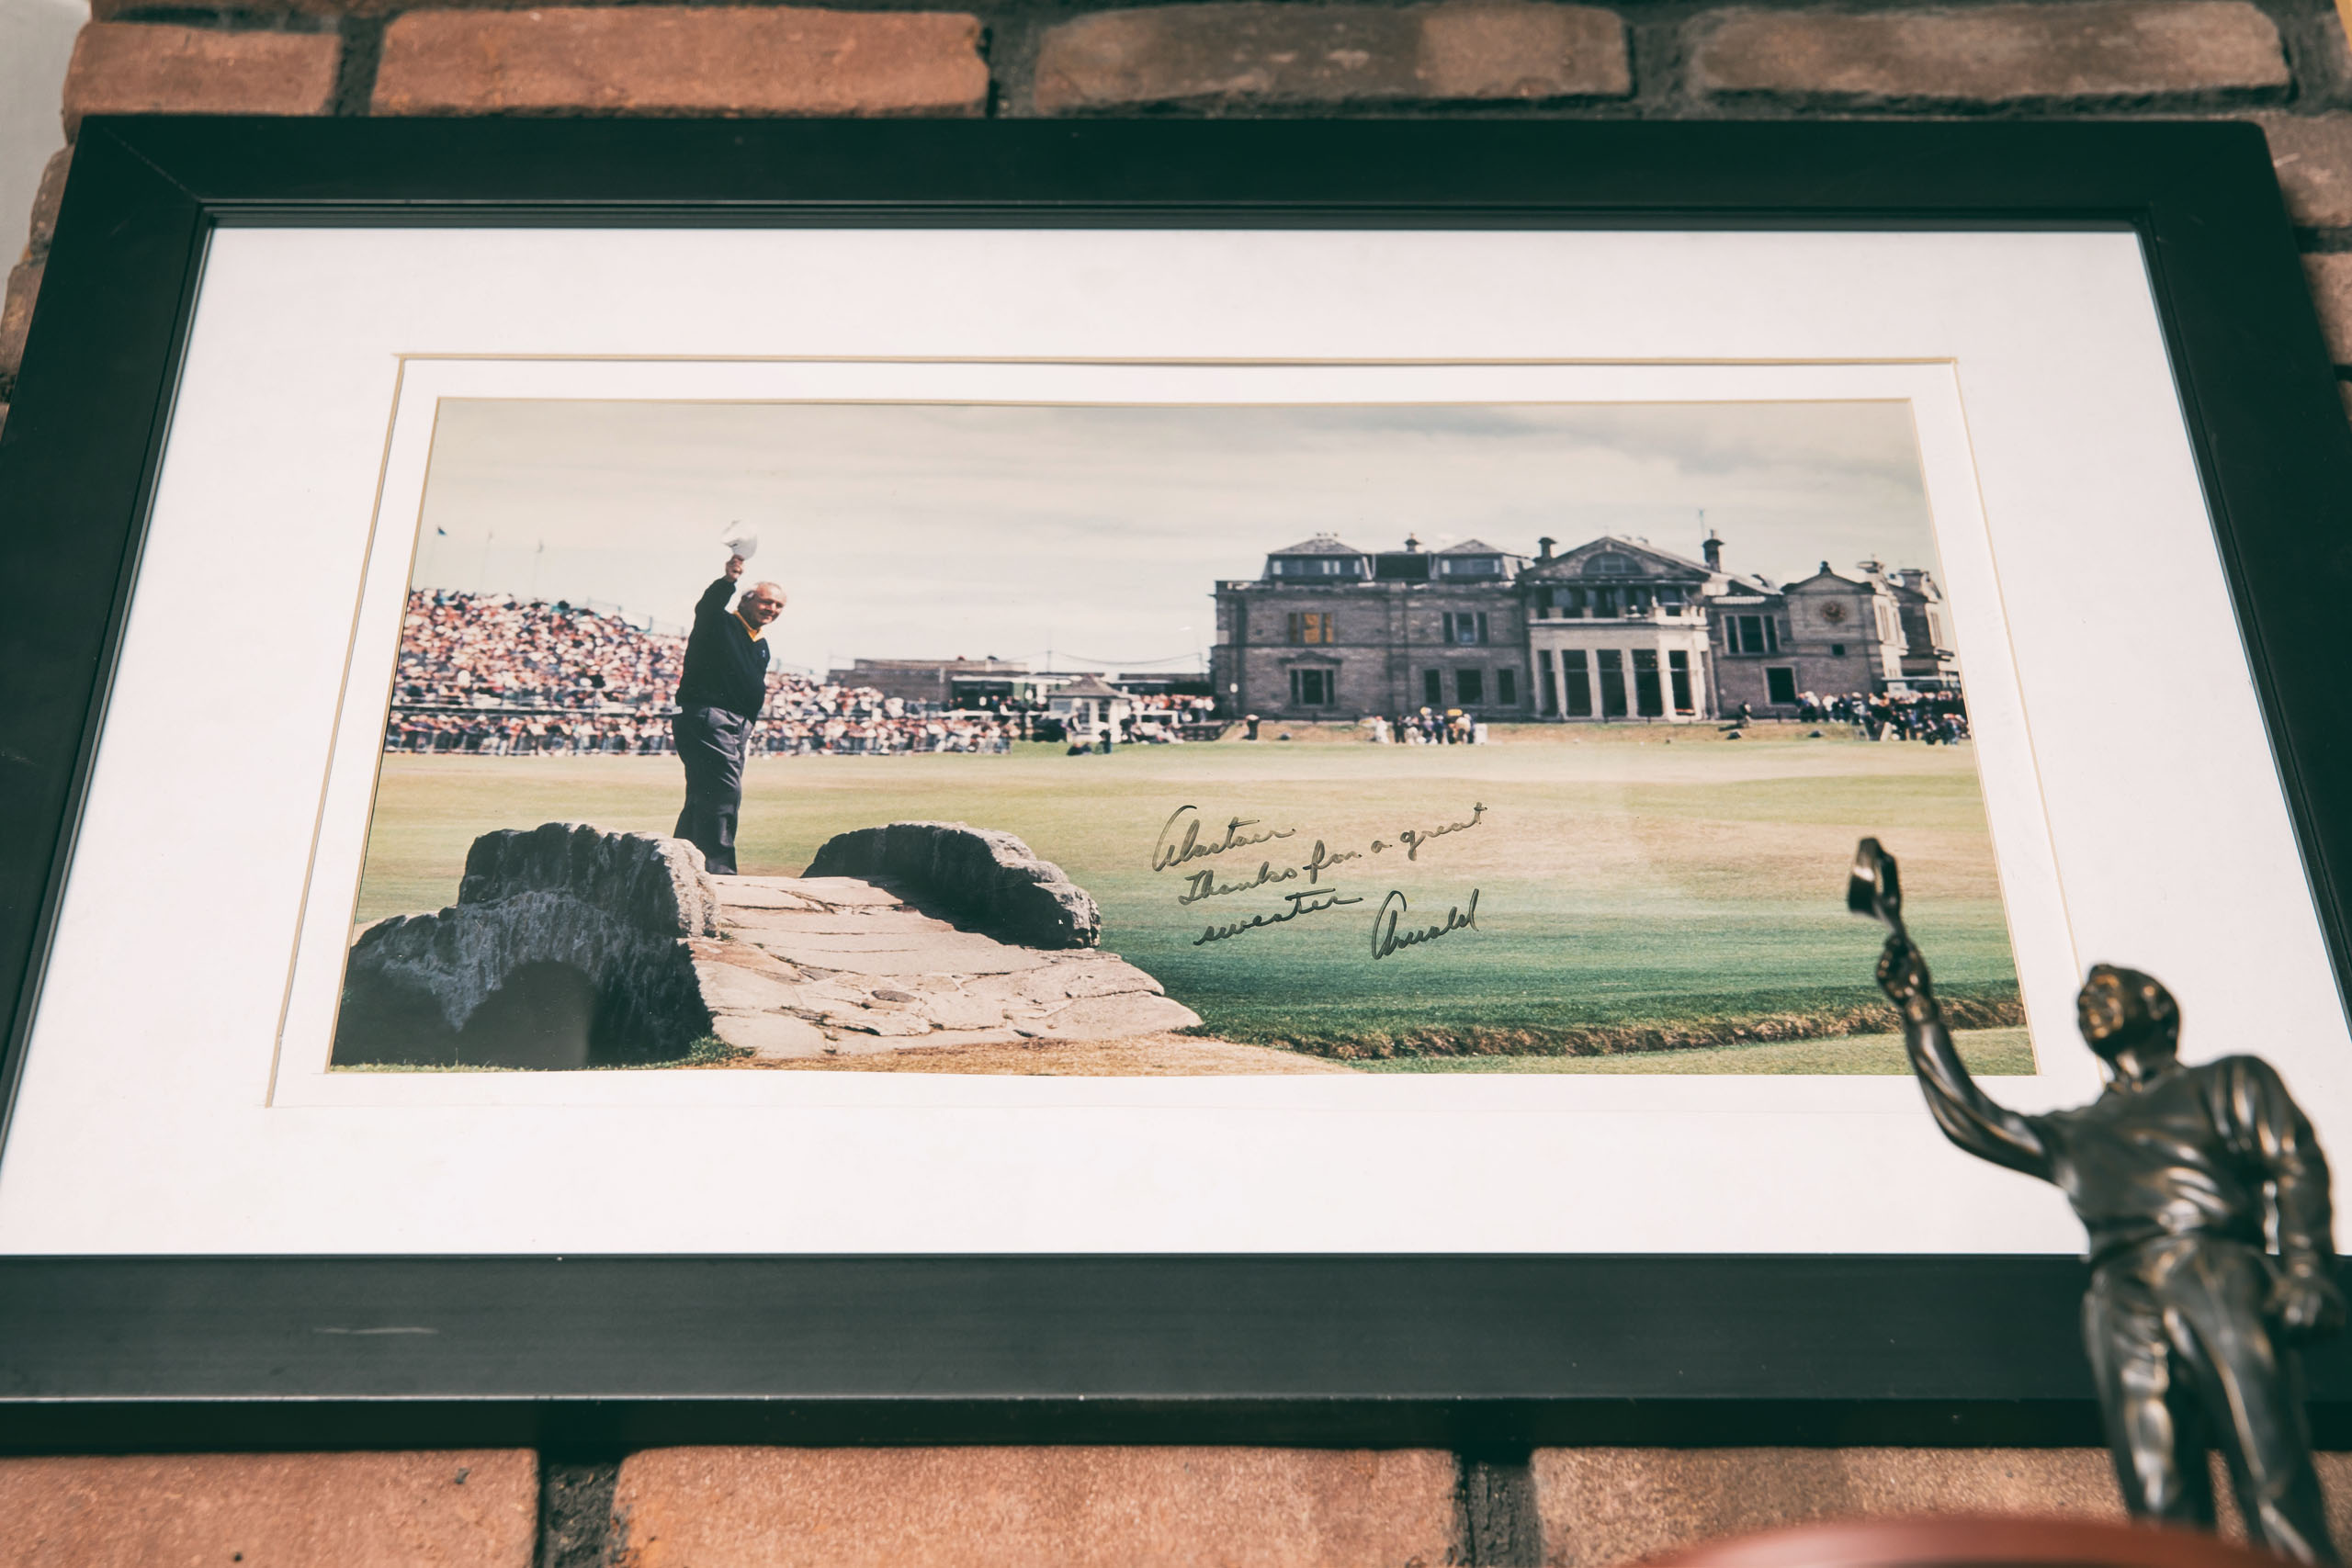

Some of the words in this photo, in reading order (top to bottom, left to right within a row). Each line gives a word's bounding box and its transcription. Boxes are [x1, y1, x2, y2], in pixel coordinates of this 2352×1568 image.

[1178, 861, 1298, 906] Thanks
[1302, 840, 1363, 884] for
[1370, 840, 1393, 853] a
[1399, 801, 1488, 862] great
[1193, 887, 1363, 945] sweater
[1371, 888, 1480, 961] Arnold
